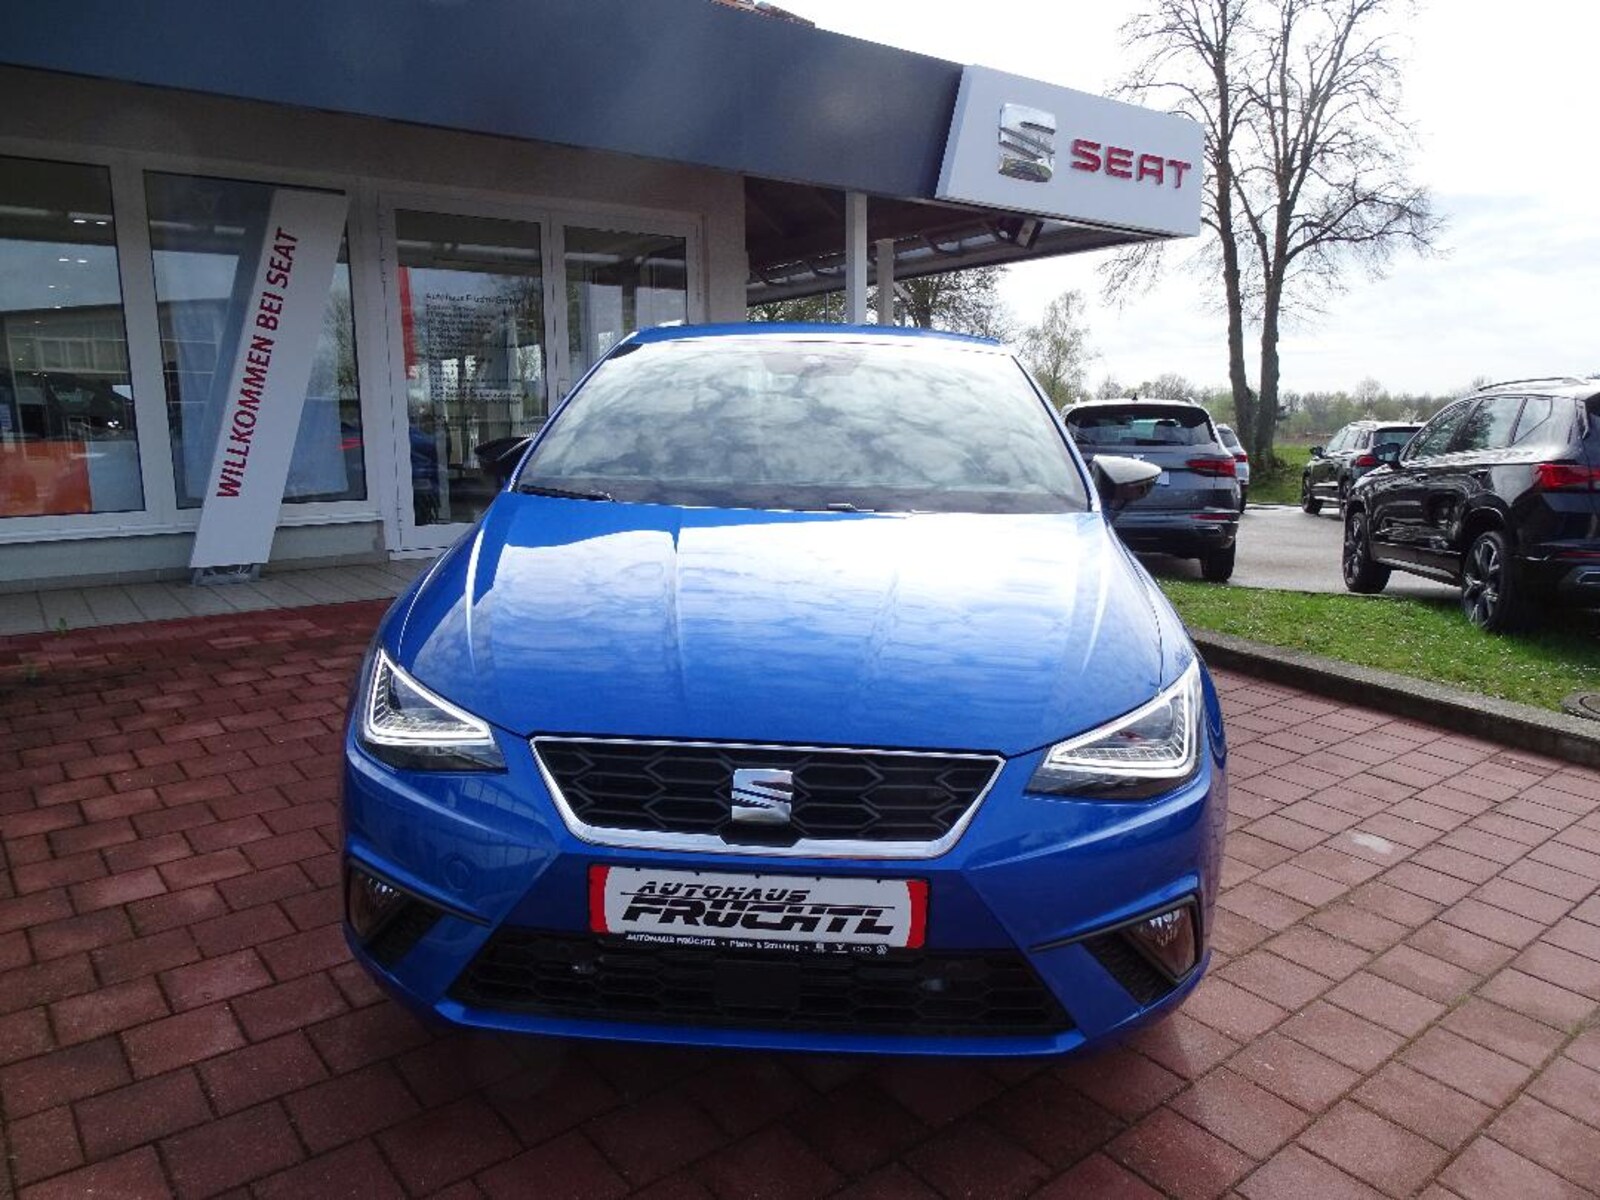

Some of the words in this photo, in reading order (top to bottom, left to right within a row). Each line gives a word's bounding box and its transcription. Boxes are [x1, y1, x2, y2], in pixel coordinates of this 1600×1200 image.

[1070, 138, 1192, 189] SEAT
[266, 226, 299, 290] SEAT
[256, 291, 284, 331] BEI
[216, 335, 275, 498] WILLKOMMEN
[636, 880, 811, 903] AUTOHAUS
